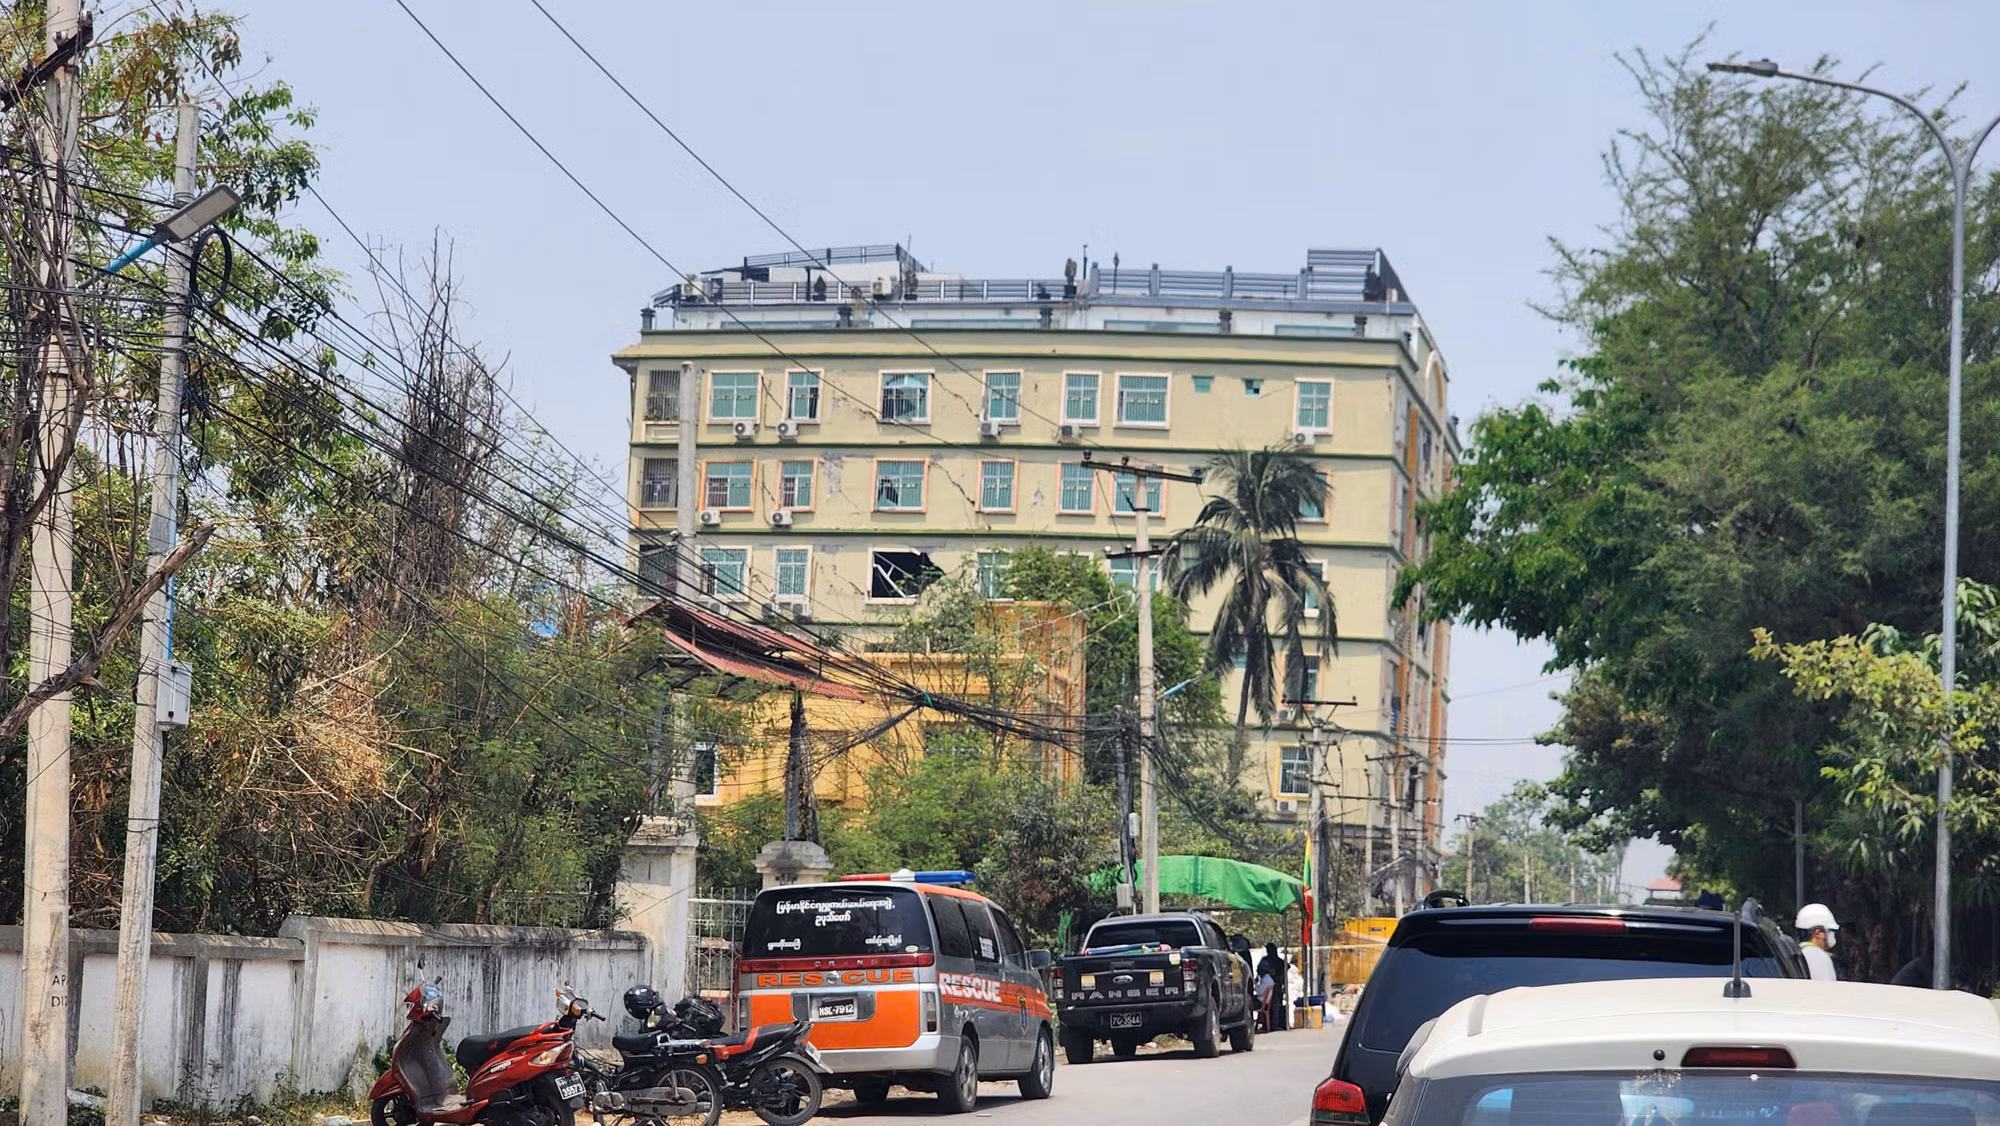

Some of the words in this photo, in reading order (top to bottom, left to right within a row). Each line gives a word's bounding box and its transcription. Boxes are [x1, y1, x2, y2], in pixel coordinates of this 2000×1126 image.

[757, 970, 914, 987] RESCUE
[939, 973, 1002, 1003] RESCUE
[1071, 987, 1178, 1000] RANGER
[562, 1083, 583, 1096] 35573
